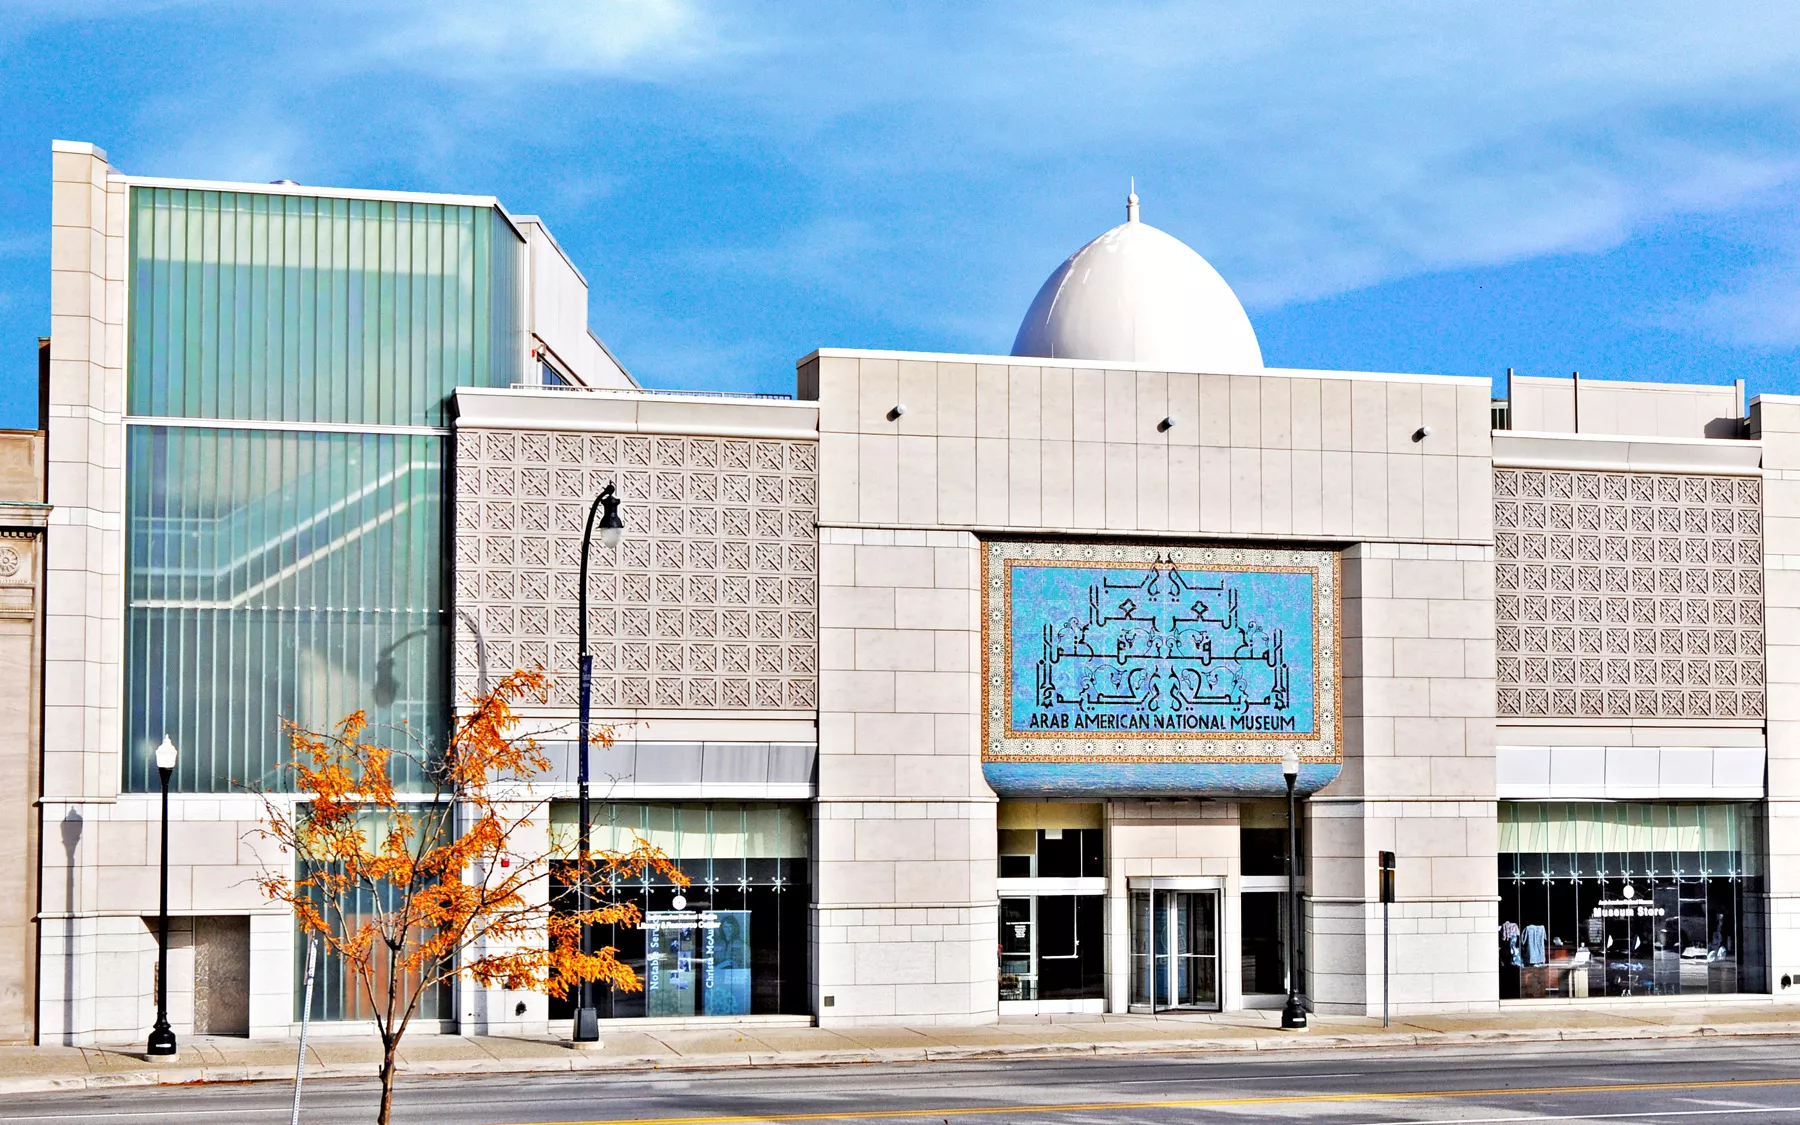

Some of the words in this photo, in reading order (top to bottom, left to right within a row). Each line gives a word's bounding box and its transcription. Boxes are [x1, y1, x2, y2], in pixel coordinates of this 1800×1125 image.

[1029, 713, 1070, 729] ARAB
[1074, 713, 1150, 730] AMERICAN
[1153, 714, 1227, 730] NATIONAL
[1230, 715, 1295, 731] MUSEUM
[1593, 907, 1634, 918] Museum
[1637, 906, 1665, 917] Store
[650, 951, 660, 991] Notable
